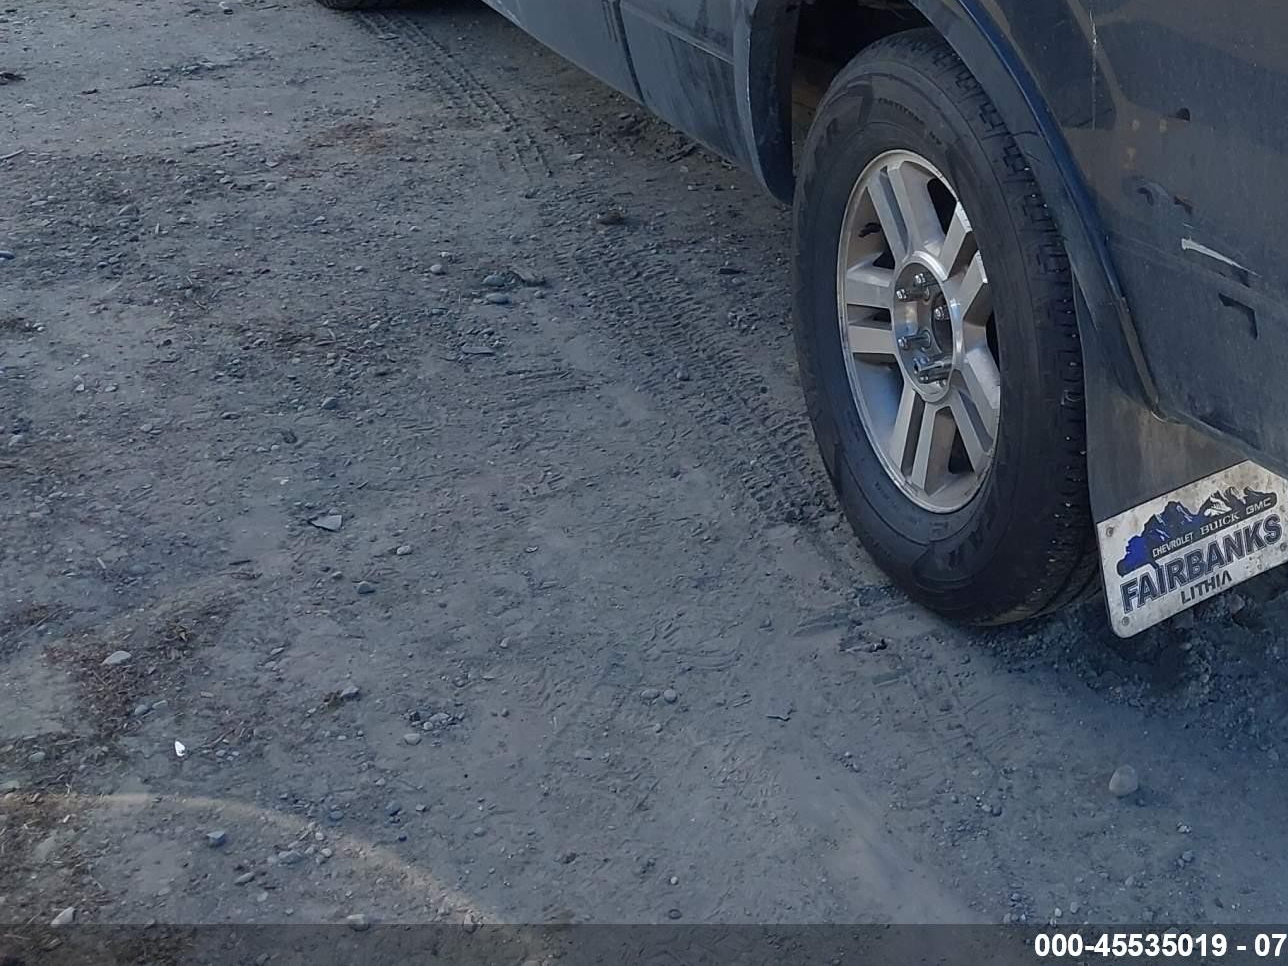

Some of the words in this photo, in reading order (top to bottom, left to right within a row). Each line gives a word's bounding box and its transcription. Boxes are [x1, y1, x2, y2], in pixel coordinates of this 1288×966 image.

[1152, 532, 1194, 558] CHEVROLET
[1200, 513, 1241, 535] BUICK
[1245, 497, 1272, 515] GMC
[1119, 513, 1284, 614] FAIRBANKS
[1180, 570, 1233, 604] LITHIA
